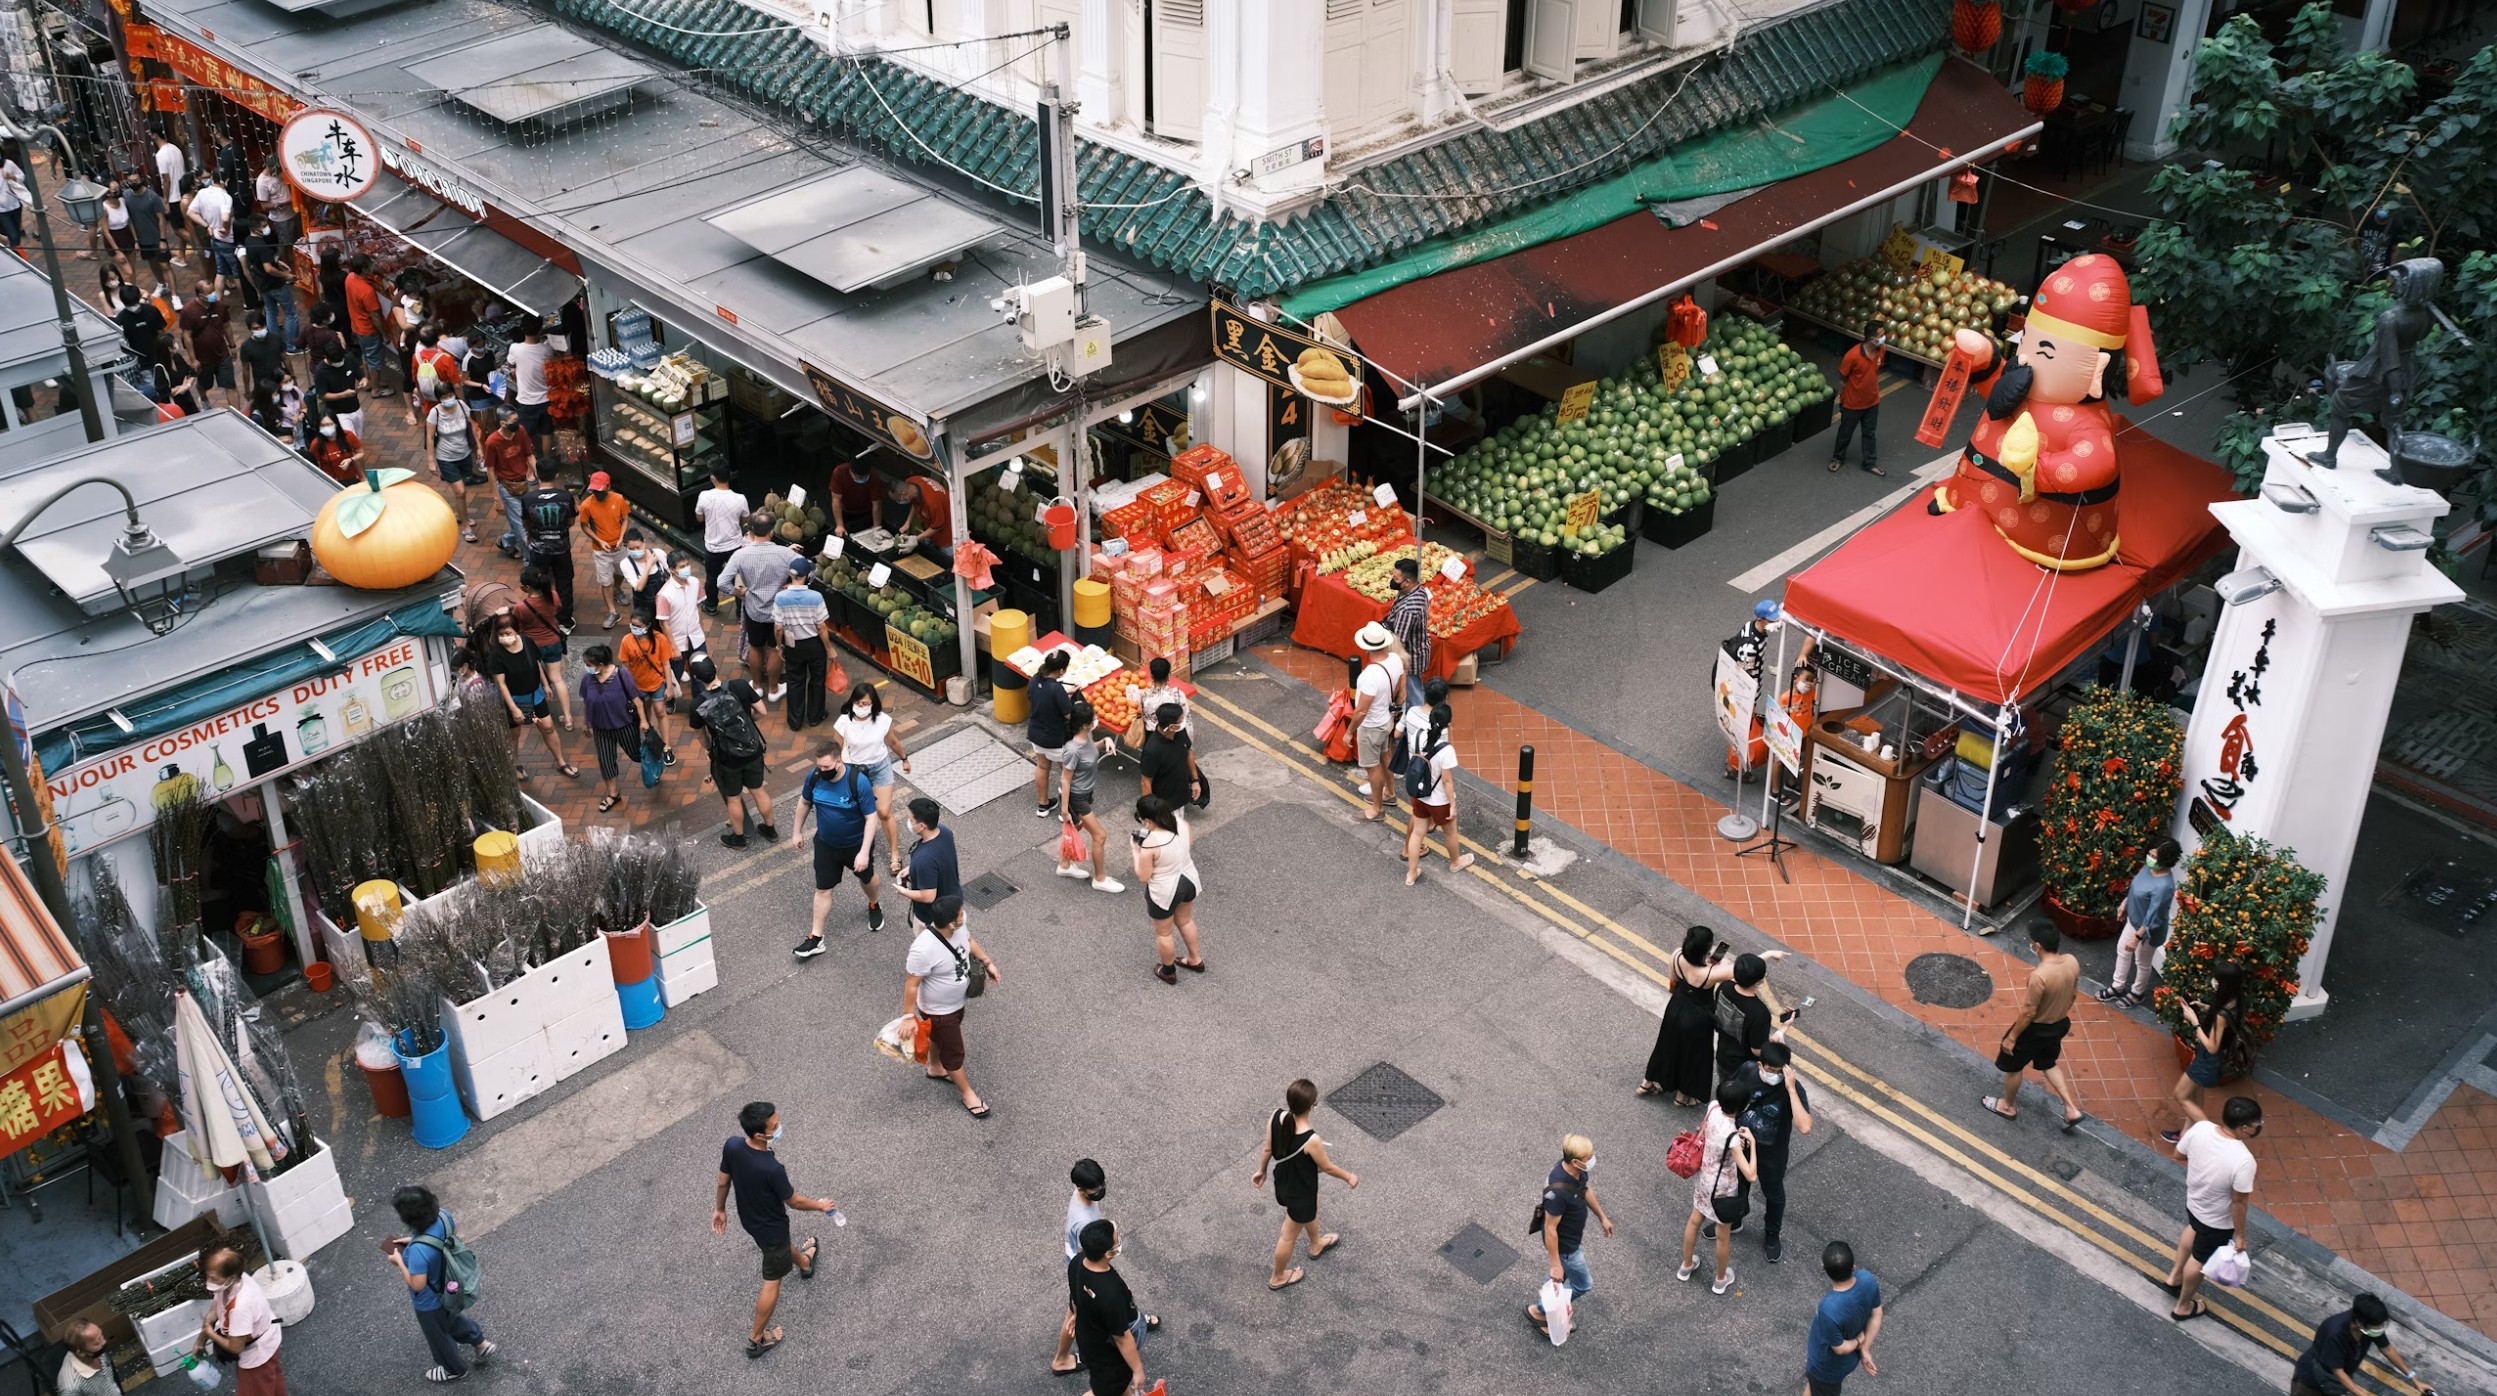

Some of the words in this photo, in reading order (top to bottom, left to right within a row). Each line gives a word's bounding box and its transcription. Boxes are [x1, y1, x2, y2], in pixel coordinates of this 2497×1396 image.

[324, 119, 364, 189] 牛车水
[1262, 151, 1283, 166] SMITH
[1284, 148, 1293, 157] ST
[1223, 319, 1291, 375] 黑金
[891, 645, 902, 669] 1
[1828, 662, 1866, 687] CREAM
[1839, 655, 1861, 674] ICE
[143, 697, 280, 763] COSMETICS
[293, 666, 355, 704] DUTY
[362, 644, 415, 677] FREE
[4, 1018, 52, 1064] 品
[0, 1059, 74, 1140] 糖果
